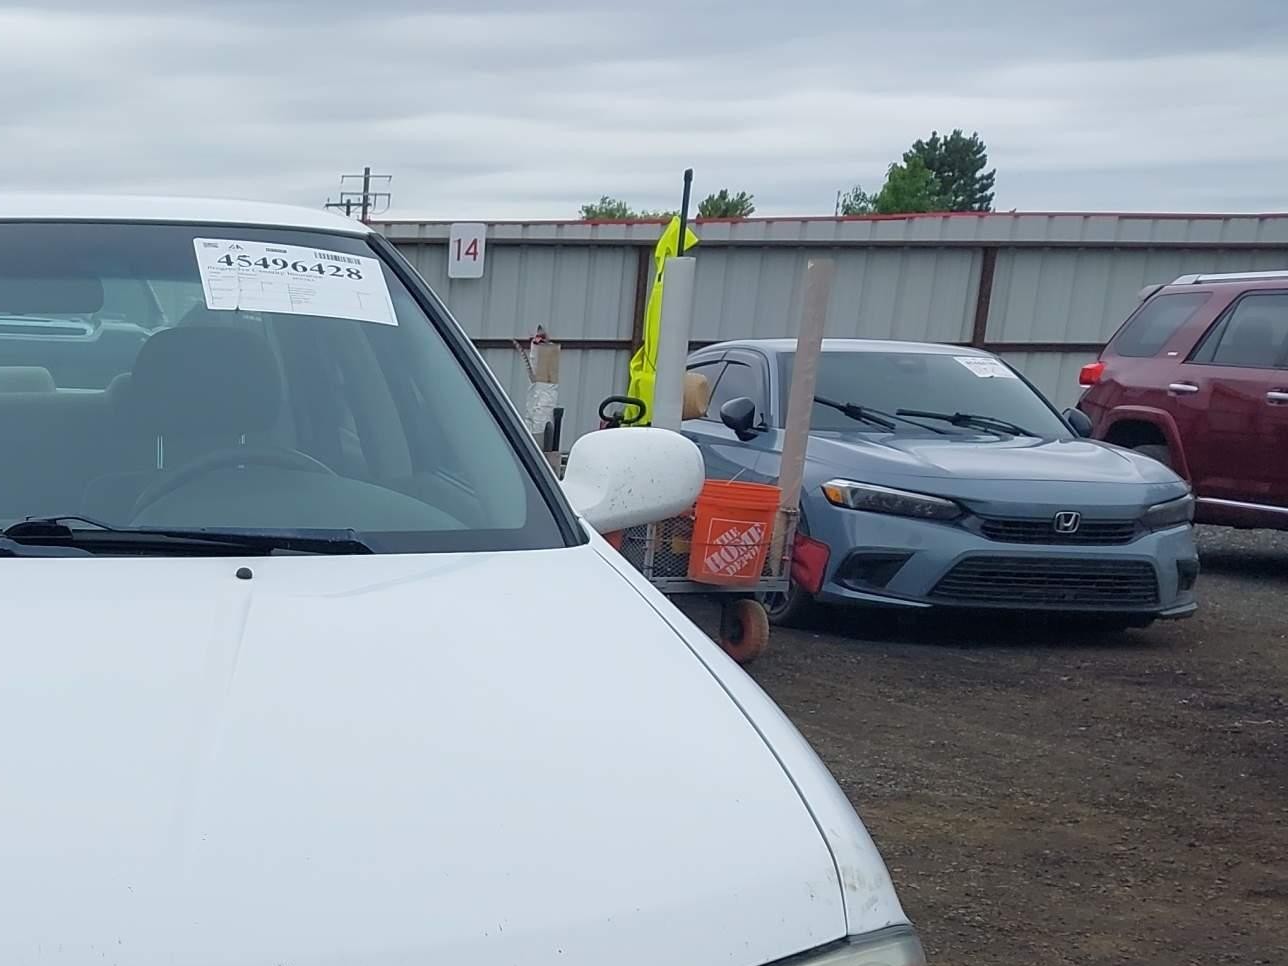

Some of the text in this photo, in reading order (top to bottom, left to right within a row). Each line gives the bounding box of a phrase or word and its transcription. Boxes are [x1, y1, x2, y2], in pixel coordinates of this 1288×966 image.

[453, 238, 479, 261] 14
[217, 253, 363, 281] 45496428
[704, 522, 763, 573] HOME
[713, 528, 740, 546] THE
